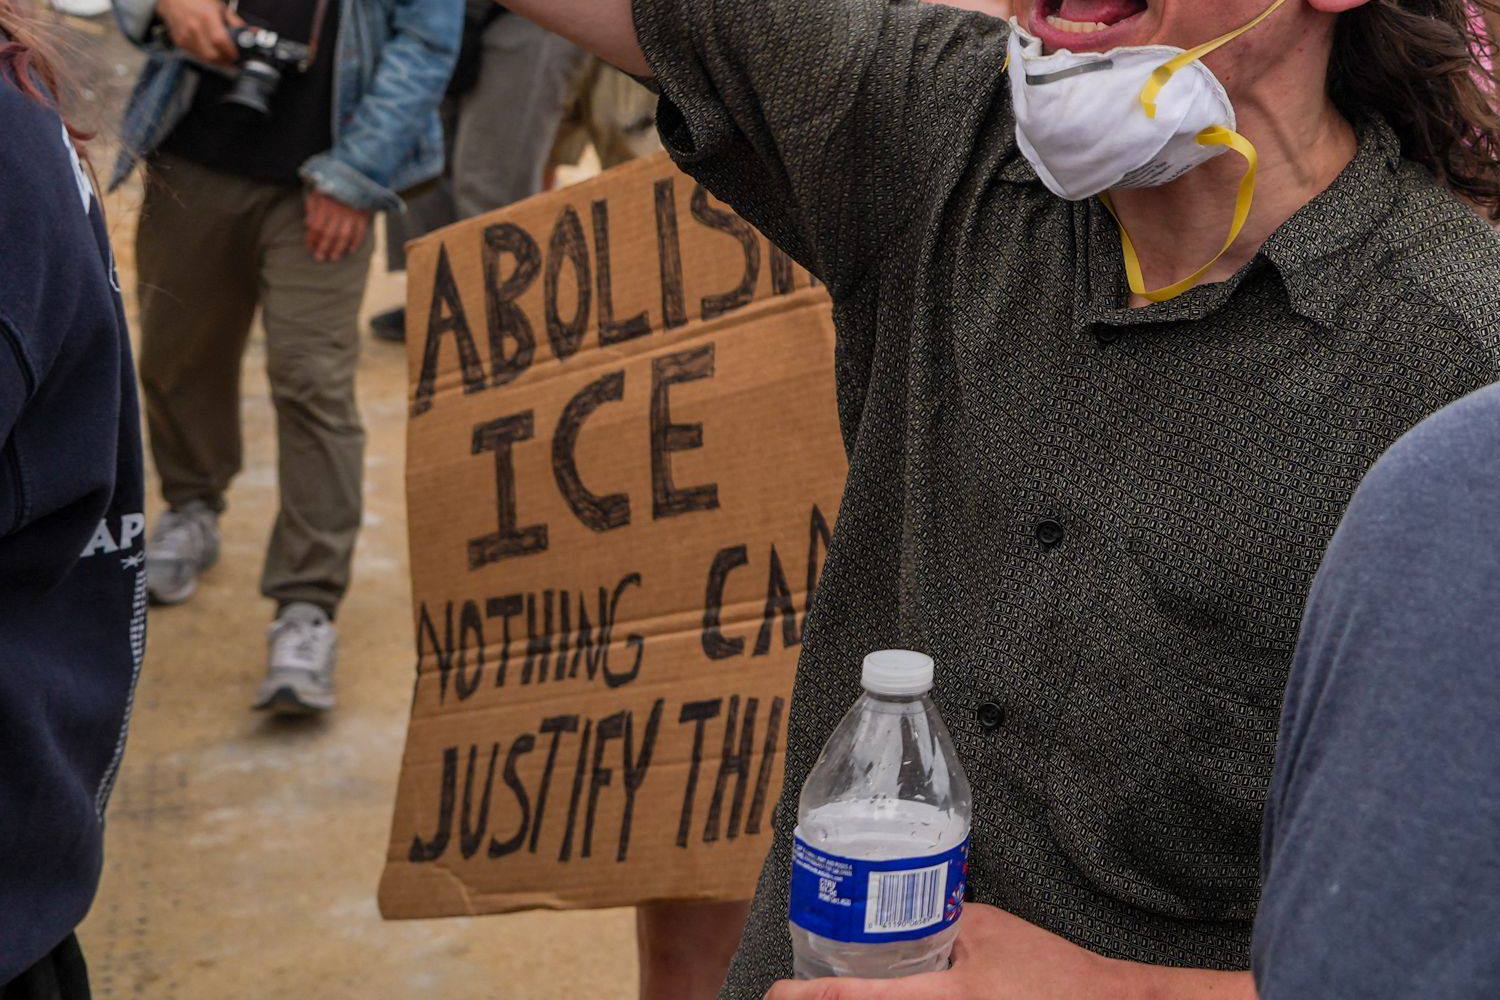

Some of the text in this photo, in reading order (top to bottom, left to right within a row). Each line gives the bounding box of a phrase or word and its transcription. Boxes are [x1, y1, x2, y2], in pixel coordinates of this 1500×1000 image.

[467, 341, 720, 571] ICE
[417, 572, 643, 705] NOTHING
[408, 693, 779, 863] JUSTIFY THI
